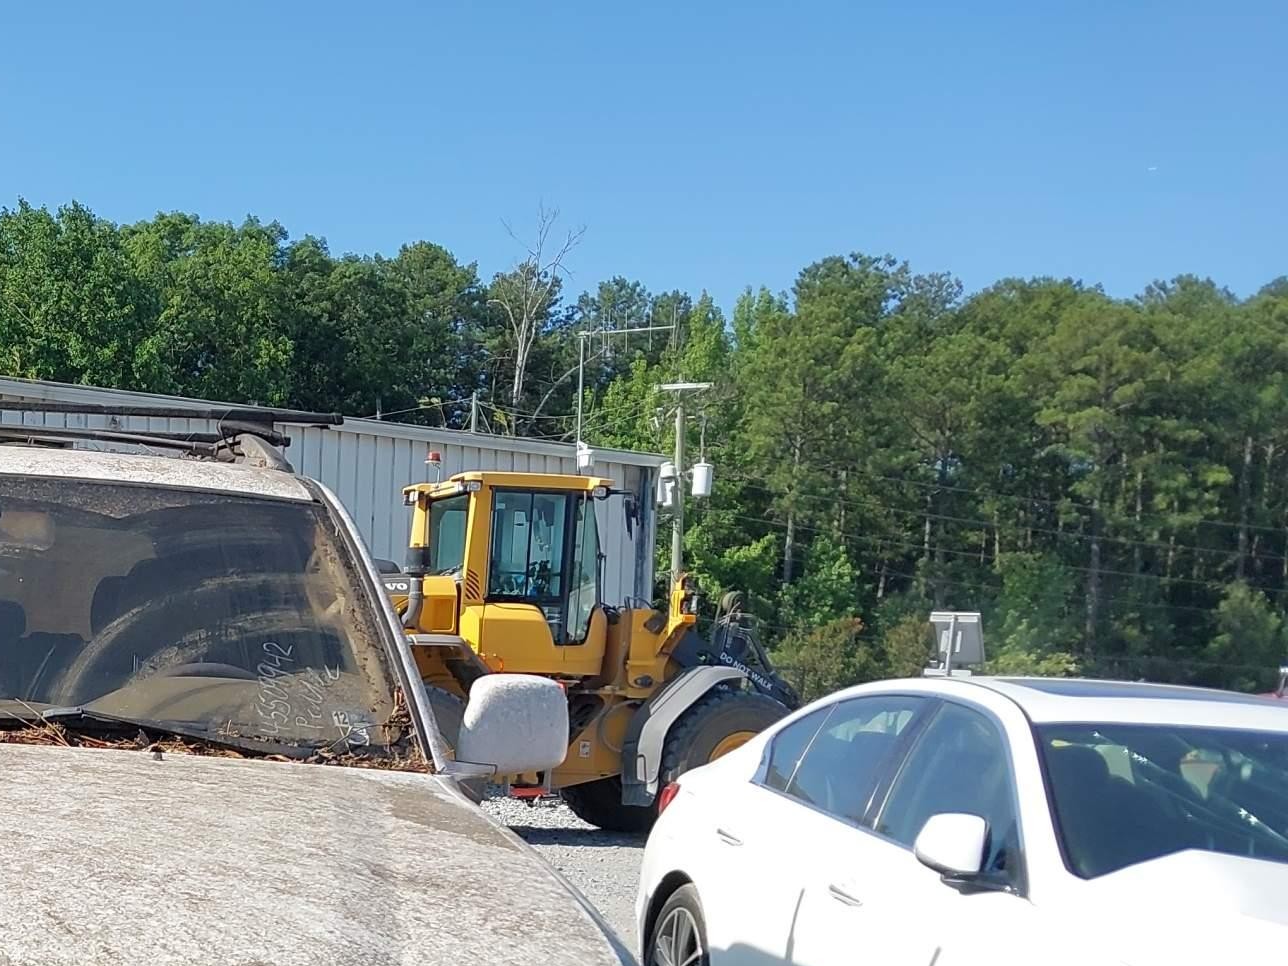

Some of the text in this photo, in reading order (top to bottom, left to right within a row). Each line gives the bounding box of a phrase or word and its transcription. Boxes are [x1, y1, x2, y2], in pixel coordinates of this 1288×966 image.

[255, 642, 294, 734] 45509942
[720, 652, 772, 690] DO NOT WALK
[333, 711, 349, 725] 12
